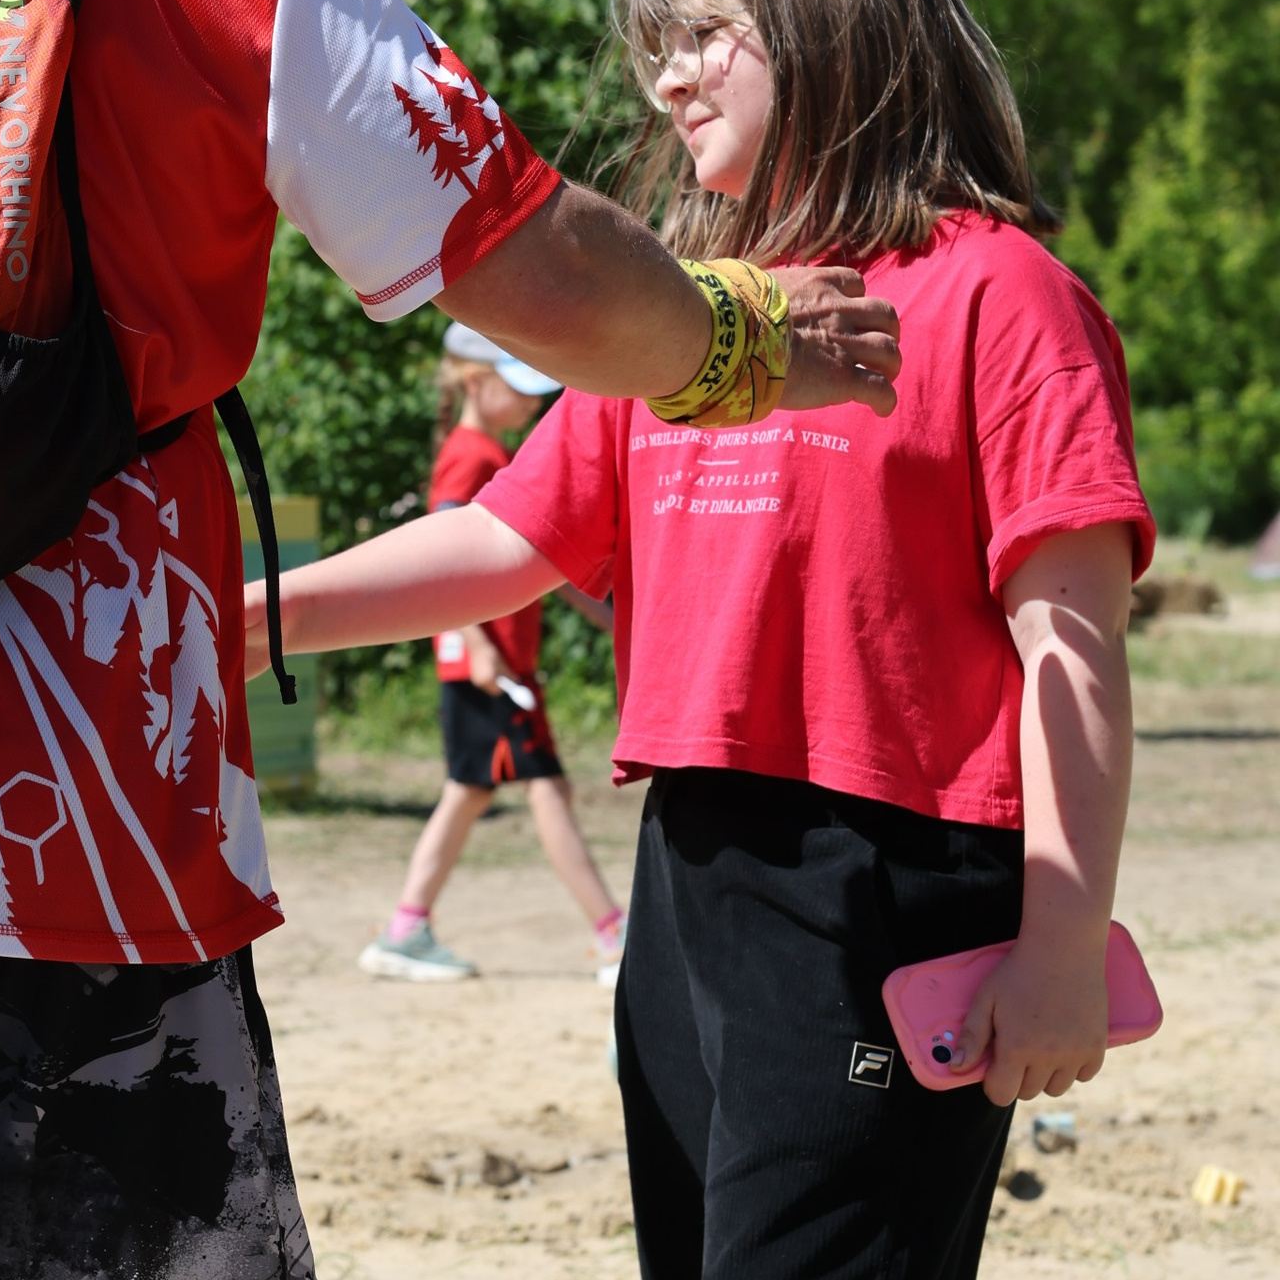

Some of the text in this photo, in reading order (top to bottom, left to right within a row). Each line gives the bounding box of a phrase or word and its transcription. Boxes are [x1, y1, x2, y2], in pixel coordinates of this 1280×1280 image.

[631, 434, 647, 452] LES
[713, 432, 748, 450] JOURS
[750, 428, 781, 444] SONT
[782, 428, 795, 443] A
[801, 430, 851, 454] VENIR
[688, 498, 709, 514] ET
[709, 497, 781, 515] DIMANCHE
